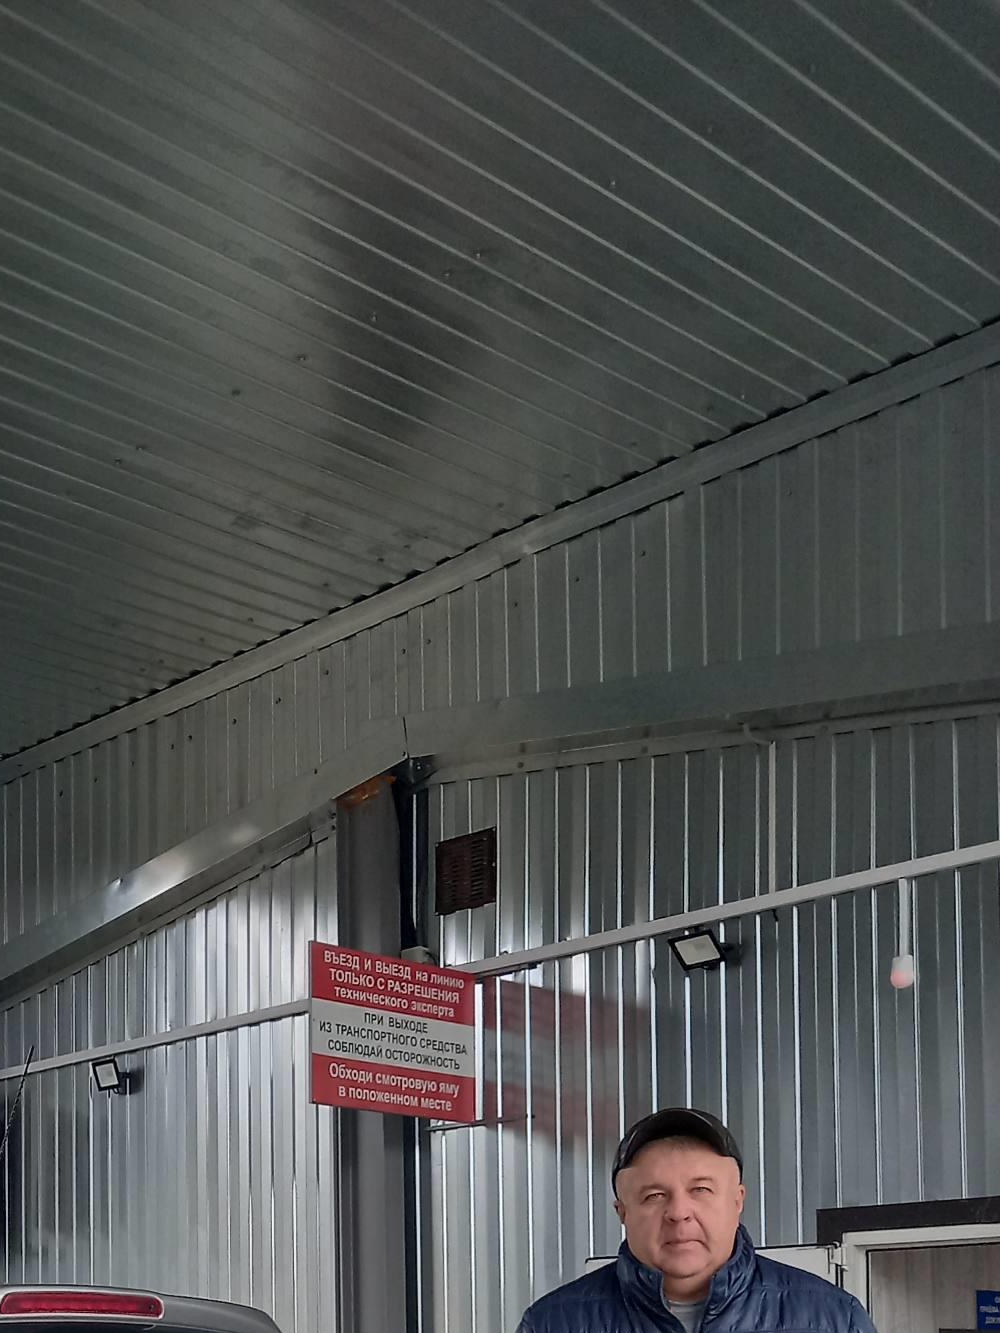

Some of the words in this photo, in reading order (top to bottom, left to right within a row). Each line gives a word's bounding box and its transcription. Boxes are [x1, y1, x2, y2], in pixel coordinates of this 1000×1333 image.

[324, 950, 360, 971] ВЪЕЗД
[364, 958, 371, 970] И
[375, 961, 411, 980] ВЫЕЗД
[415, 970, 428, 982] на
[430, 973, 465, 989] линию
[329, 968, 375, 988] ТОЛЬКО
[376, 977, 385, 990] С
[387, 980, 459, 1004] РАЗРЕШЕНИЯ
[334, 986, 409, 1010] технического
[411, 1001, 455, 1018] эксперта
[319, 1020, 332, 1033] ИЗ
[335, 1023, 417, 1047] ТРАНСПОРТНОГО
[419, 1038, 468, 1055] СРЕДСТВА
[364, 1012, 384, 1025] ПРИ
[388, 1016, 428, 1034] ВЫХОДЕ
[328, 1039, 383, 1059] СОБЛЮДАЙ
[385, 1049, 460, 1070] ОСТОРОЖНОСТЬ
[329, 1062, 373, 1086] Обходи
[375, 1074, 437, 1094] смотровую
[439, 1082, 460, 1098] яму
[338, 1085, 346, 1097] в
[348, 1086, 419, 1107] положенном
[420, 1096, 452, 1111] месте
